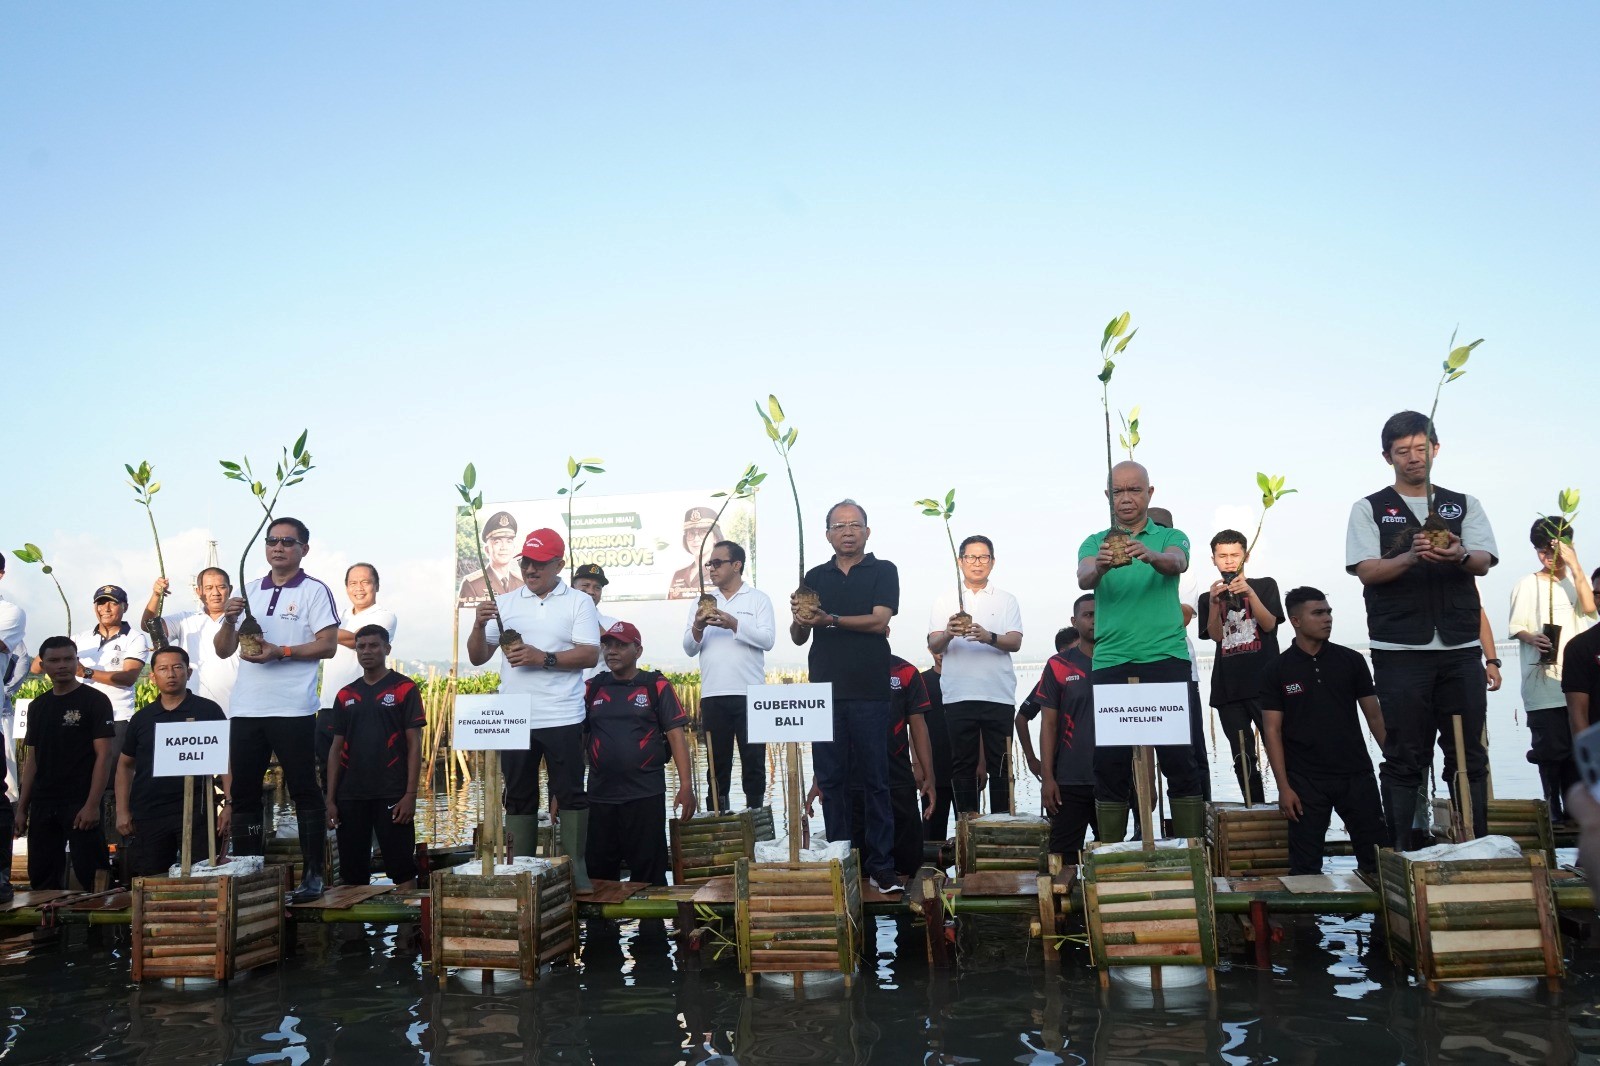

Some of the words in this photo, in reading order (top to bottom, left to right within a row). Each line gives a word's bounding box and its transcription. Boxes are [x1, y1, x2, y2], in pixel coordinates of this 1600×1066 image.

[571, 517, 613, 526] KOLABORASI
[569, 534, 635, 550] WARISKAN
[753, 699, 826, 710] GUBERNUR
[1098, 706, 1125, 714] JAKSA
[1127, 705, 1157, 713] AGUNG
[775, 716, 804, 726] BALI
[165, 735, 219, 746] KAPOLDA
[178, 751, 204, 761] BALI
